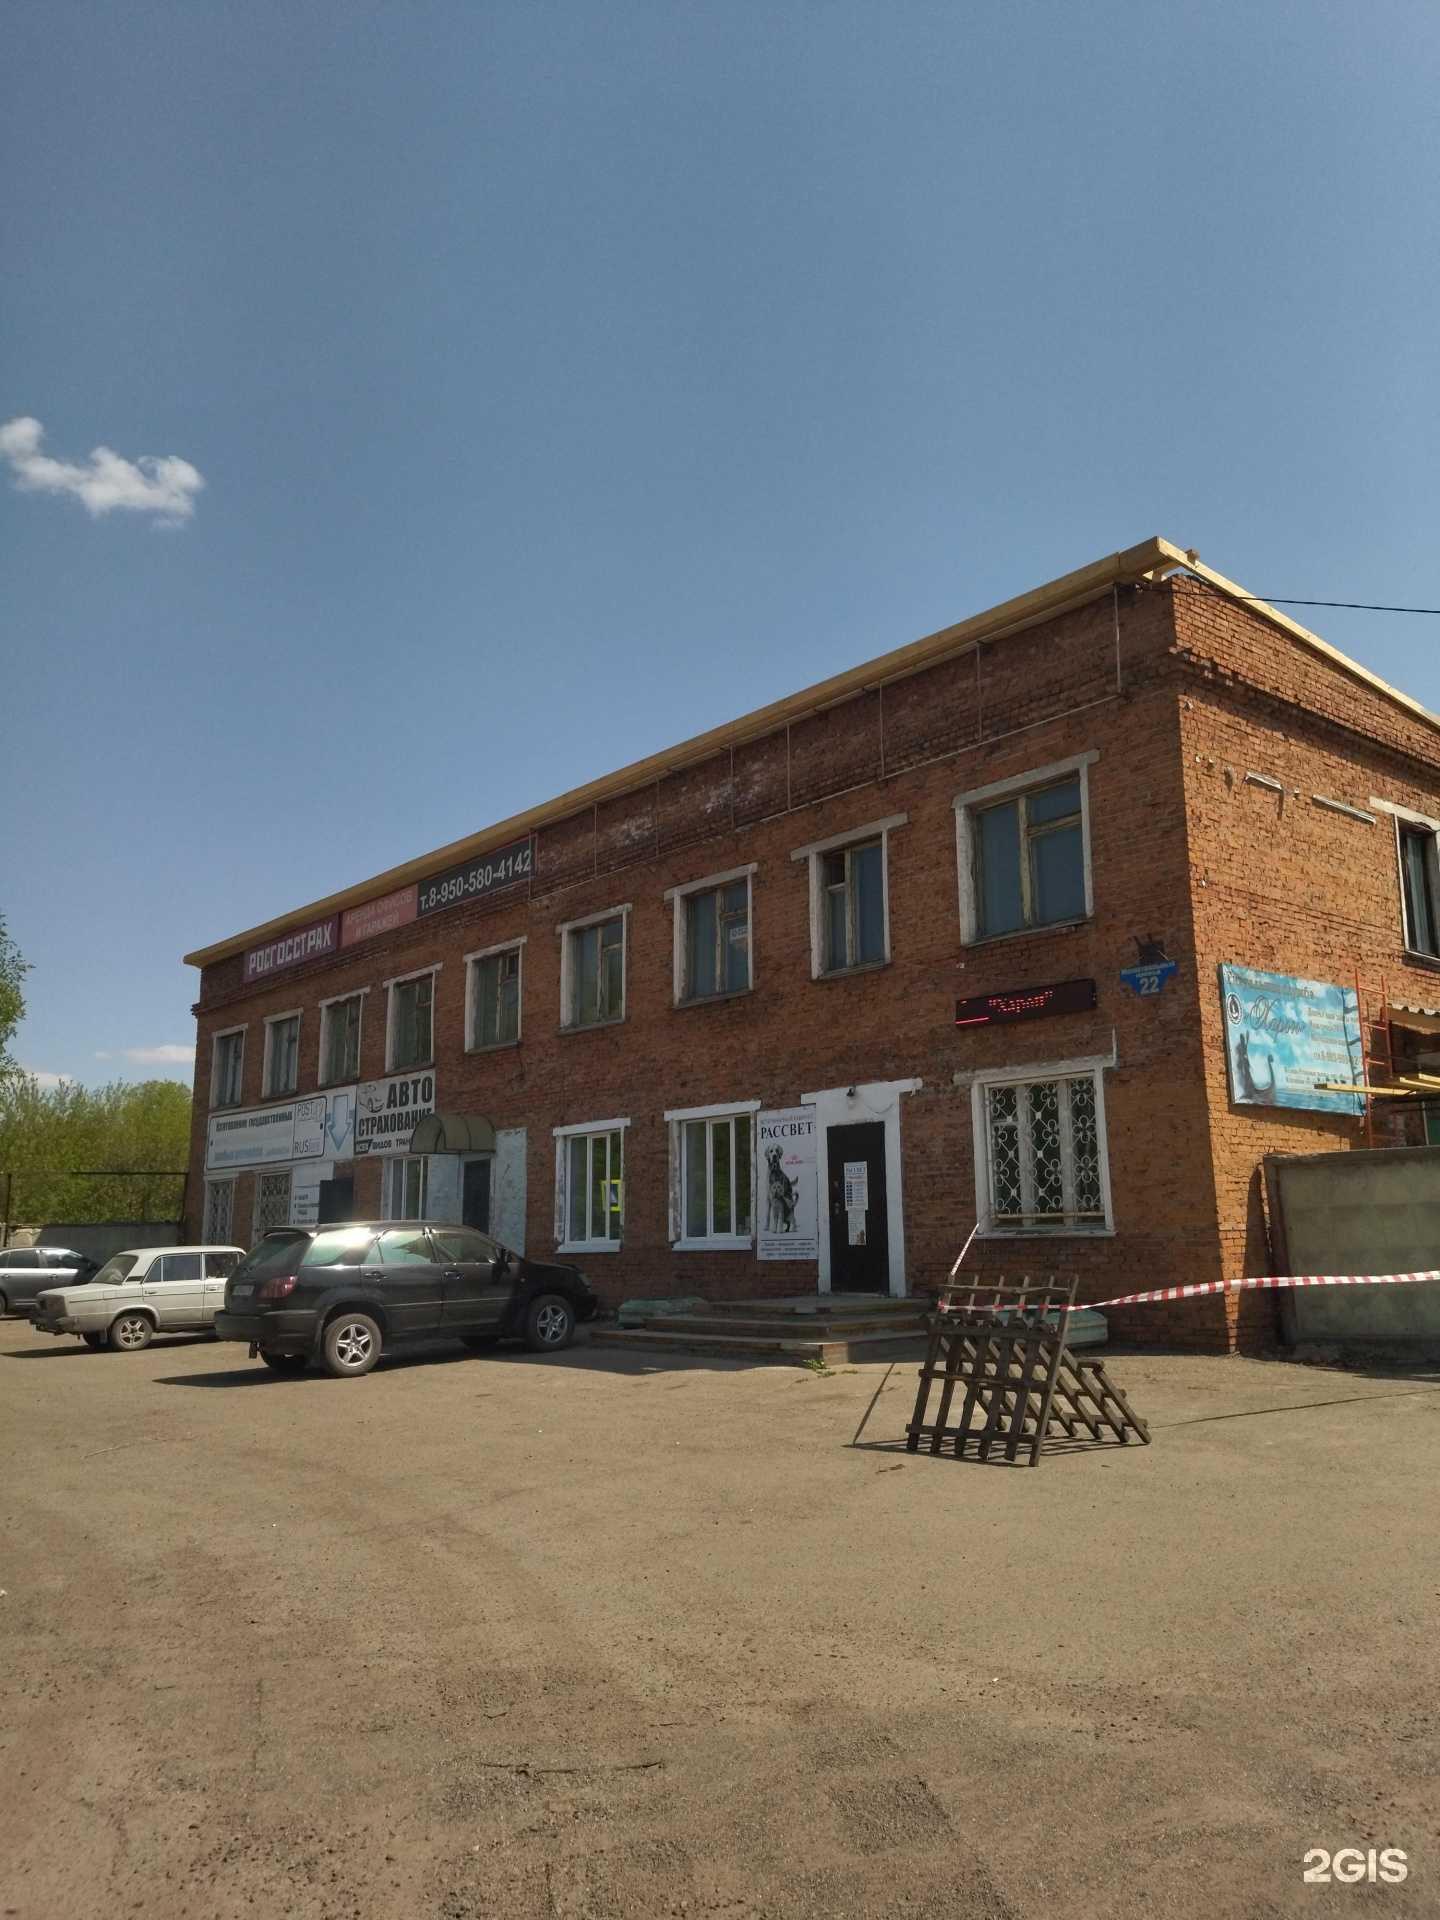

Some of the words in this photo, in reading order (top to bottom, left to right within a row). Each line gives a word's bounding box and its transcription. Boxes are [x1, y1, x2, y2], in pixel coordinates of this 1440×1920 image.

[420, 850, 532, 910] т.8-950-580-4142
[249, 922, 332, 975] РОСГОССТРАХ
[1139, 976, 1160, 995] 22
[386, 1076, 433, 1109] АВТО
[761, 1121, 813, 1140] РАССВЕТ
